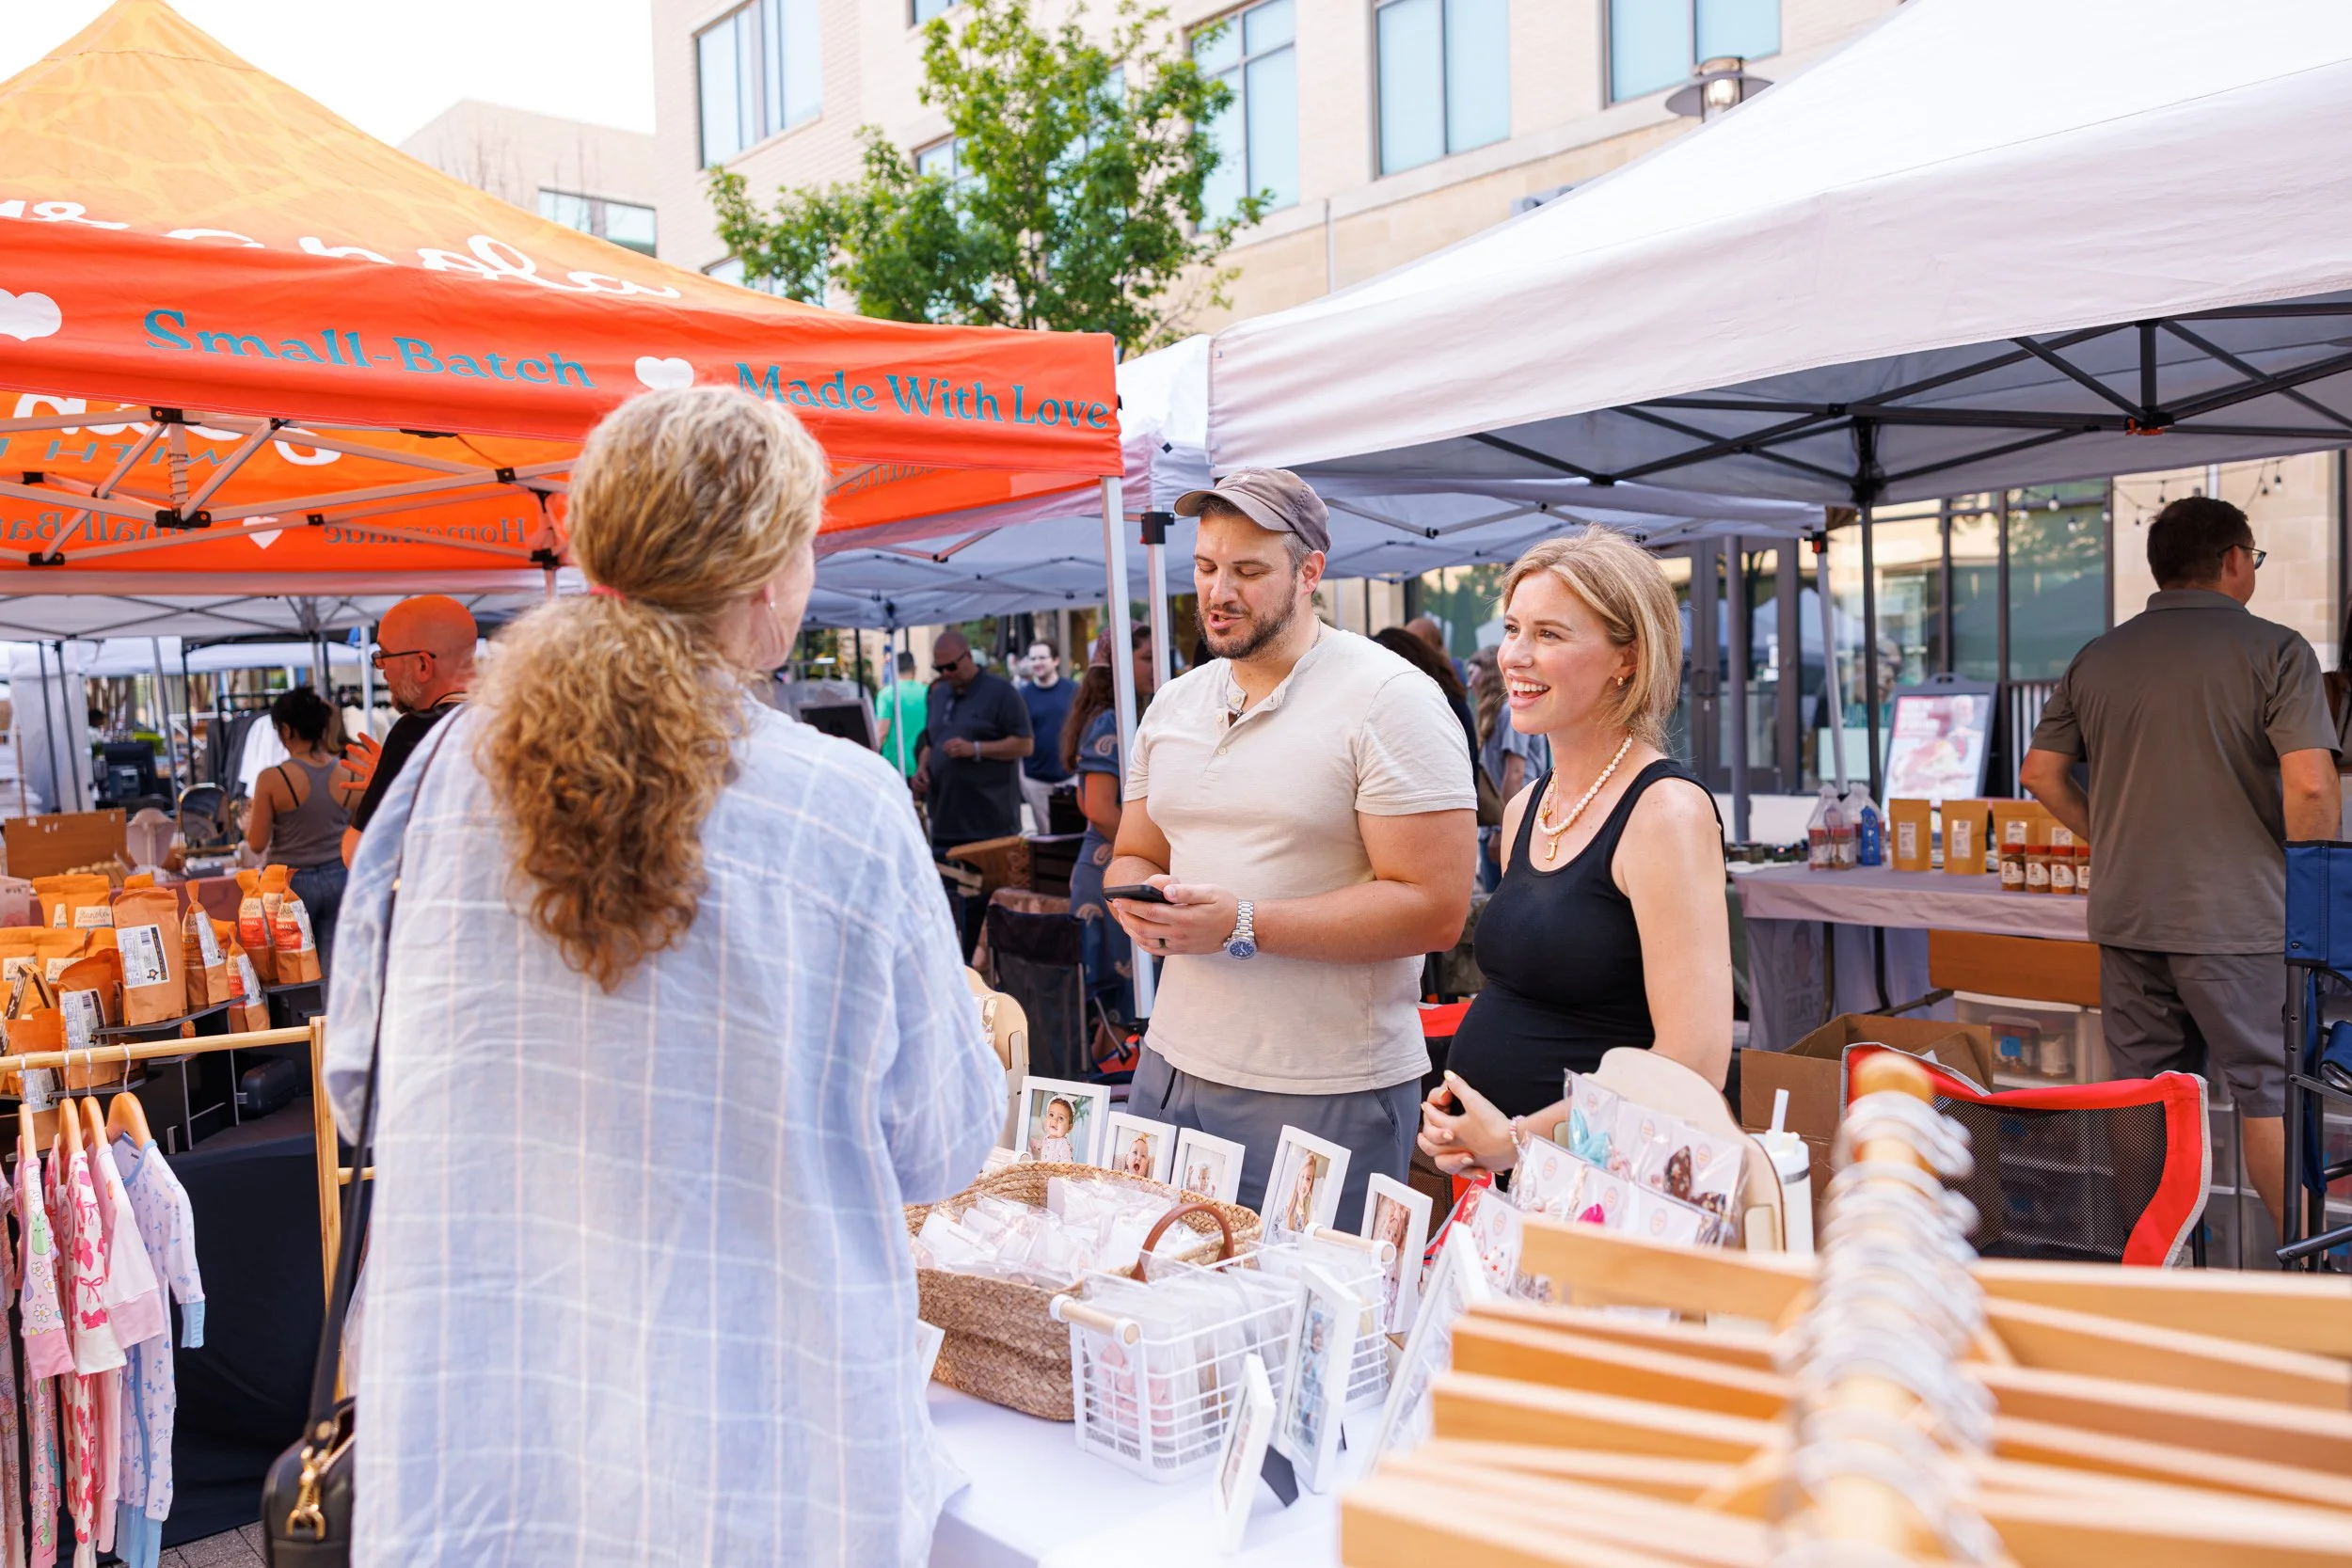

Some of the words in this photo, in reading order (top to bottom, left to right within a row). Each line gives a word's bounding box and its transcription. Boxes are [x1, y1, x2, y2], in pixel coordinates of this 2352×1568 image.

[144, 309, 597, 388] Small-Batch
[735, 362, 879, 412] Made
[885, 374, 1003, 422] With
[1011, 385, 1109, 429] Love
